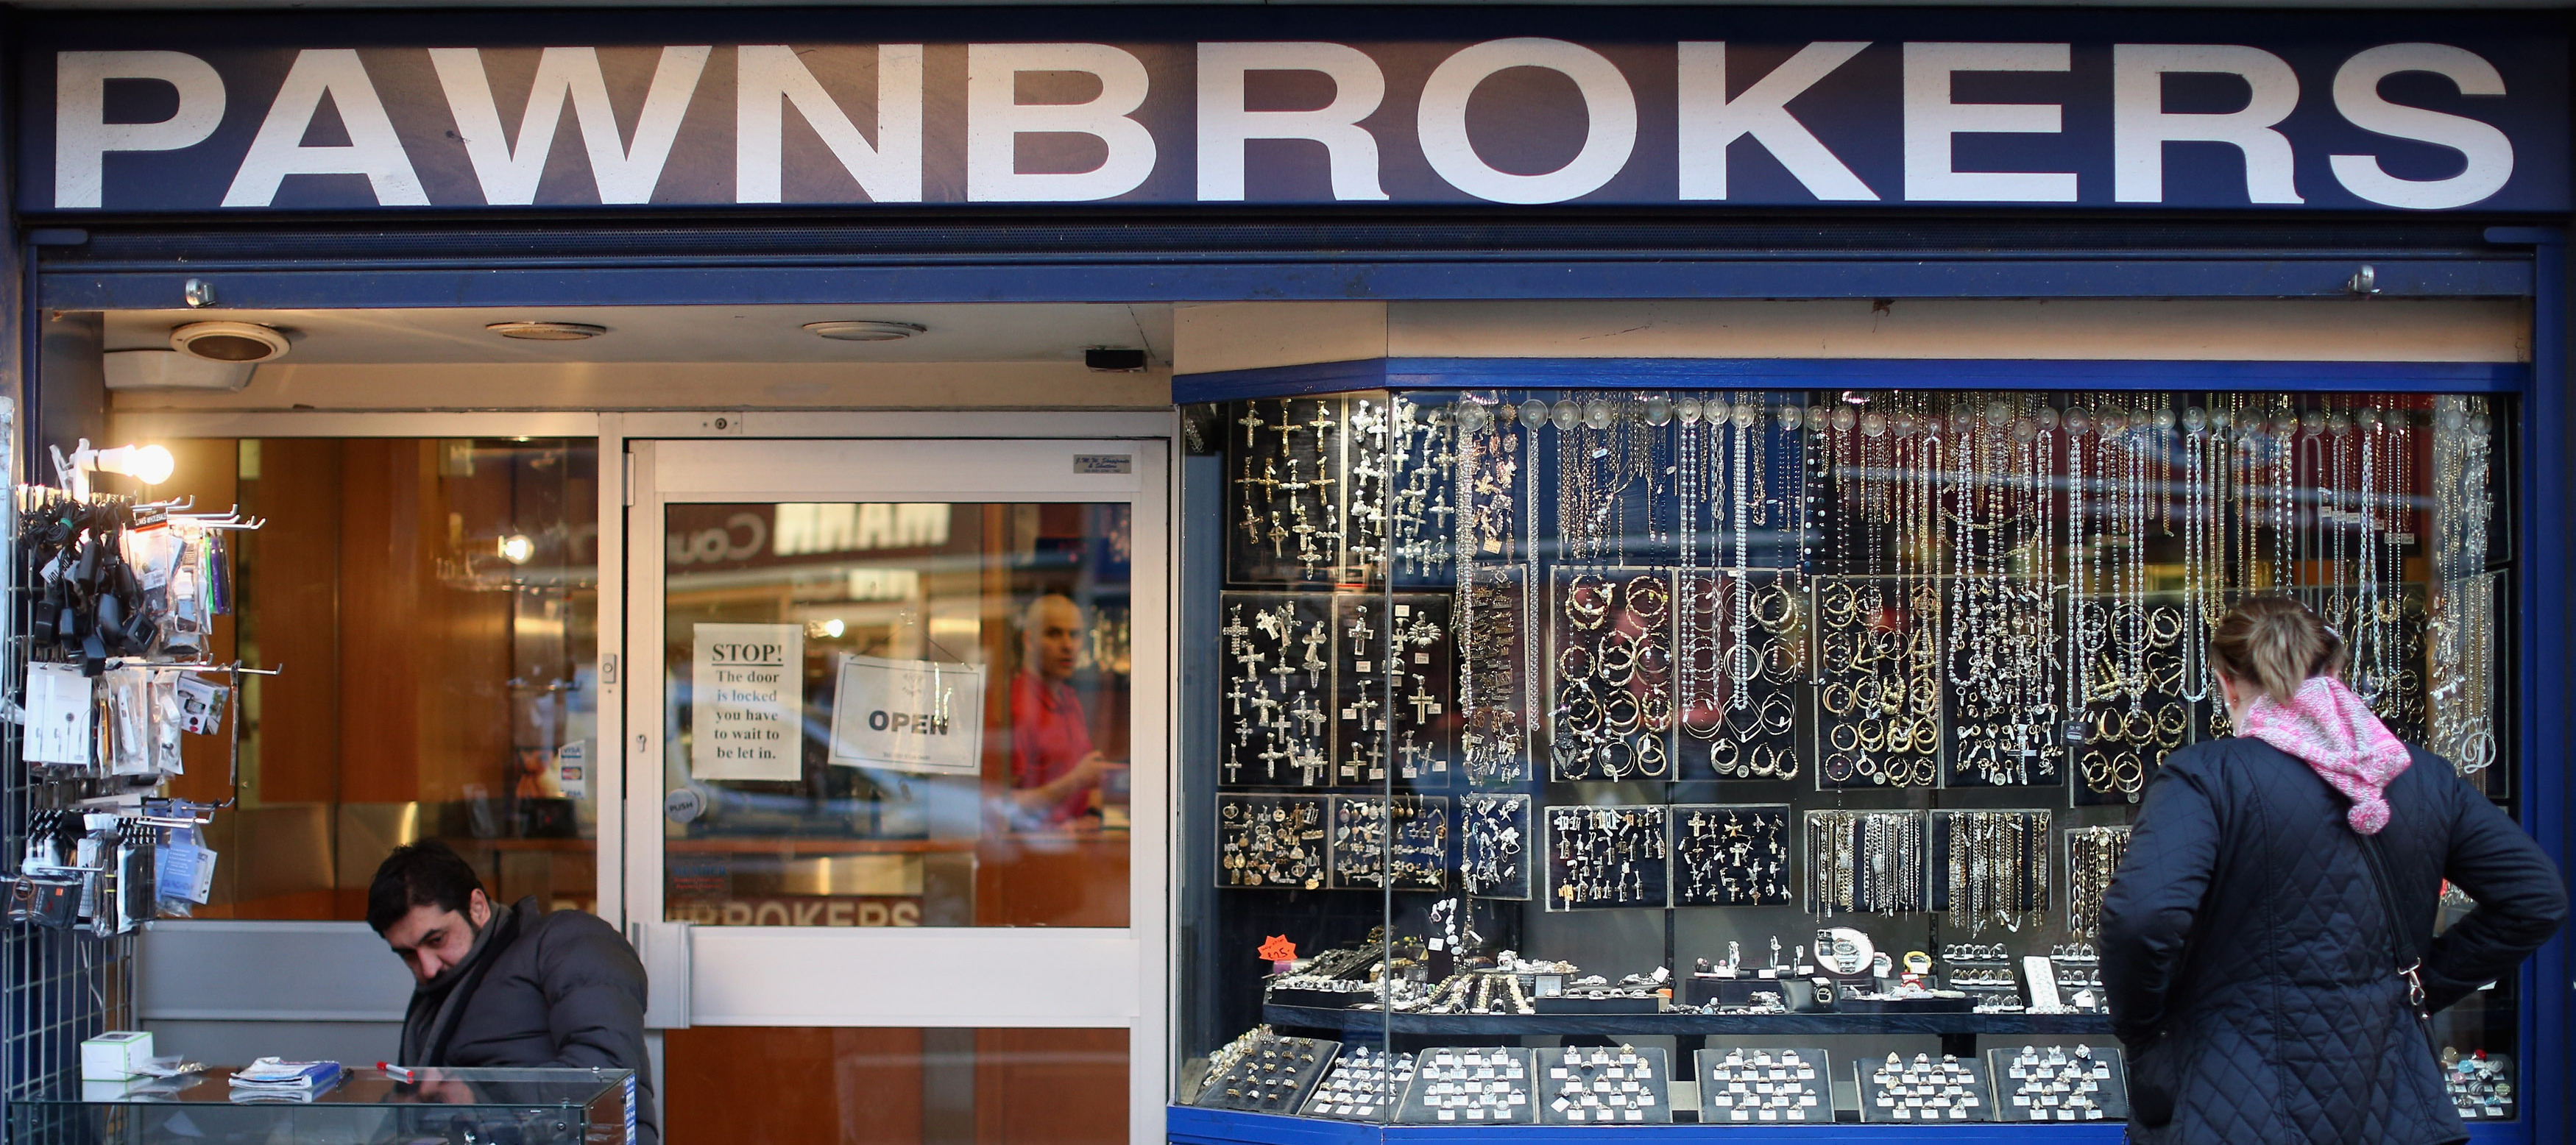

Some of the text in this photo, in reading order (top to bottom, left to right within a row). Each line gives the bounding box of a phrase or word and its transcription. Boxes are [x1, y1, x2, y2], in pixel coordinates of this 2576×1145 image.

[54, 38, 2514, 210] PAWNBROKERS
[712, 643, 782, 662] STOP!
[717, 670, 780, 683] The door
[717, 690, 777, 702] is locked
[716, 709, 779, 724] you have
[868, 709, 949, 736] OPEN
[714, 728, 780, 741] to wait to
[717, 746, 776, 759] be let in.
[669, 801, 693, 812] PUSH
